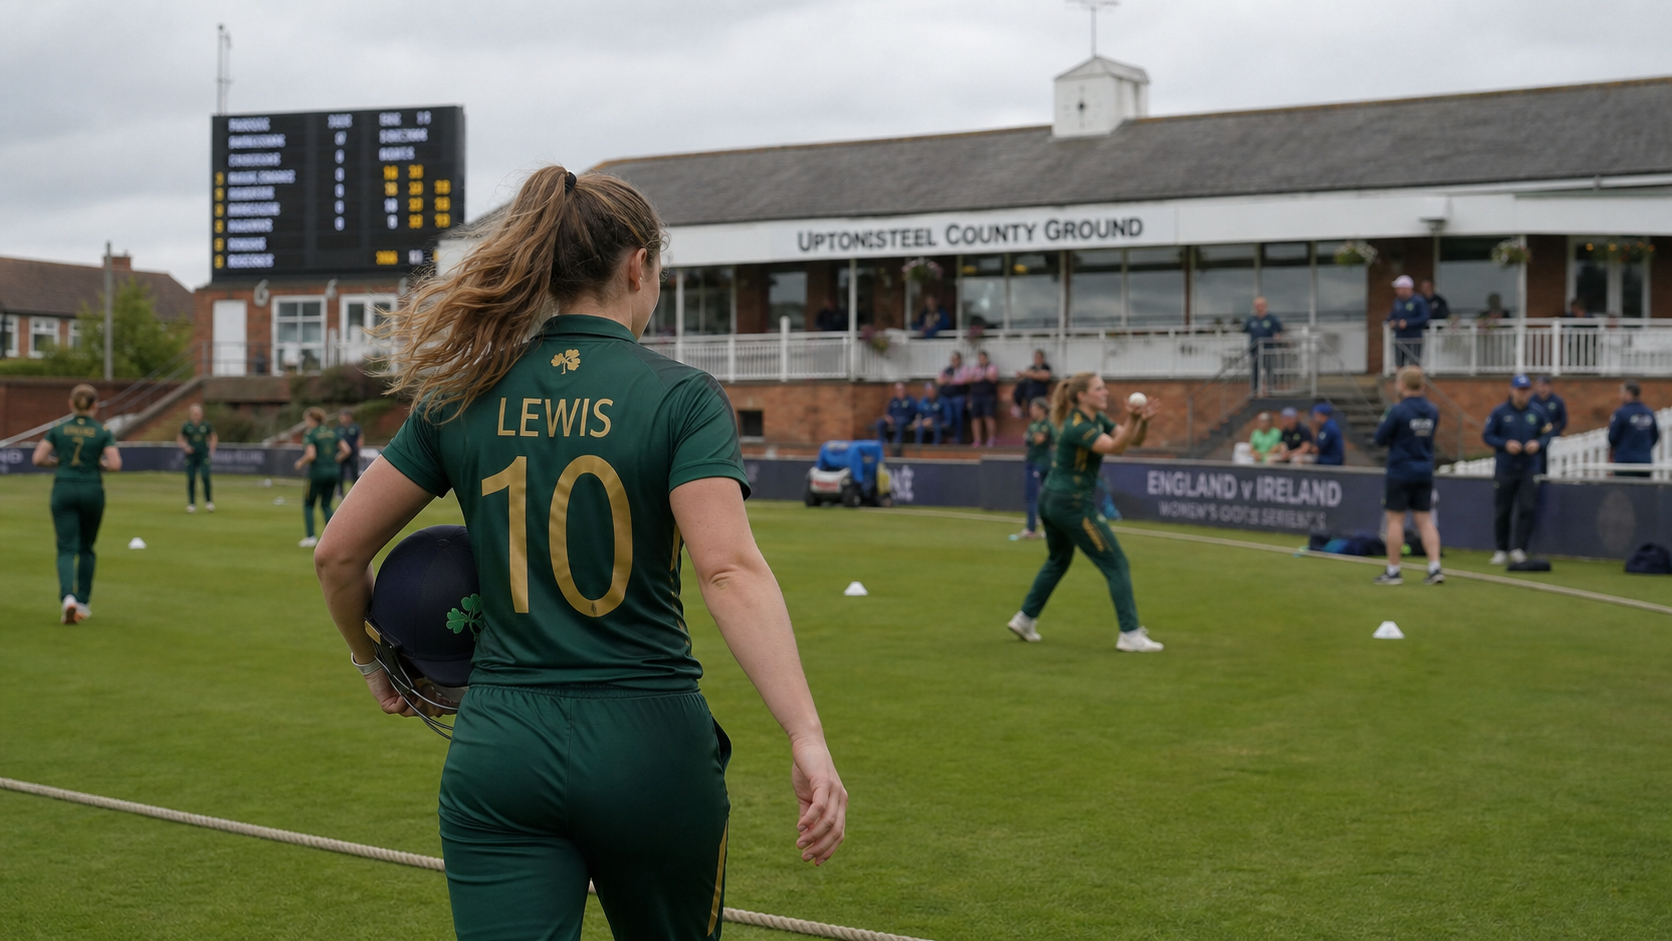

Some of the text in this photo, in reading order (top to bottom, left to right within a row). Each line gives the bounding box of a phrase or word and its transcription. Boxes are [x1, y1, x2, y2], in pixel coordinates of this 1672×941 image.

[945, 223, 1036, 245] COUNTY
[1045, 217, 1143, 241] GROUND
[497, 397, 614, 438] LEWIS
[1147, 470, 1238, 500] ENGLAND
[1256, 475, 1342, 508] IRELAND
[481, 454, 633, 618] 10
